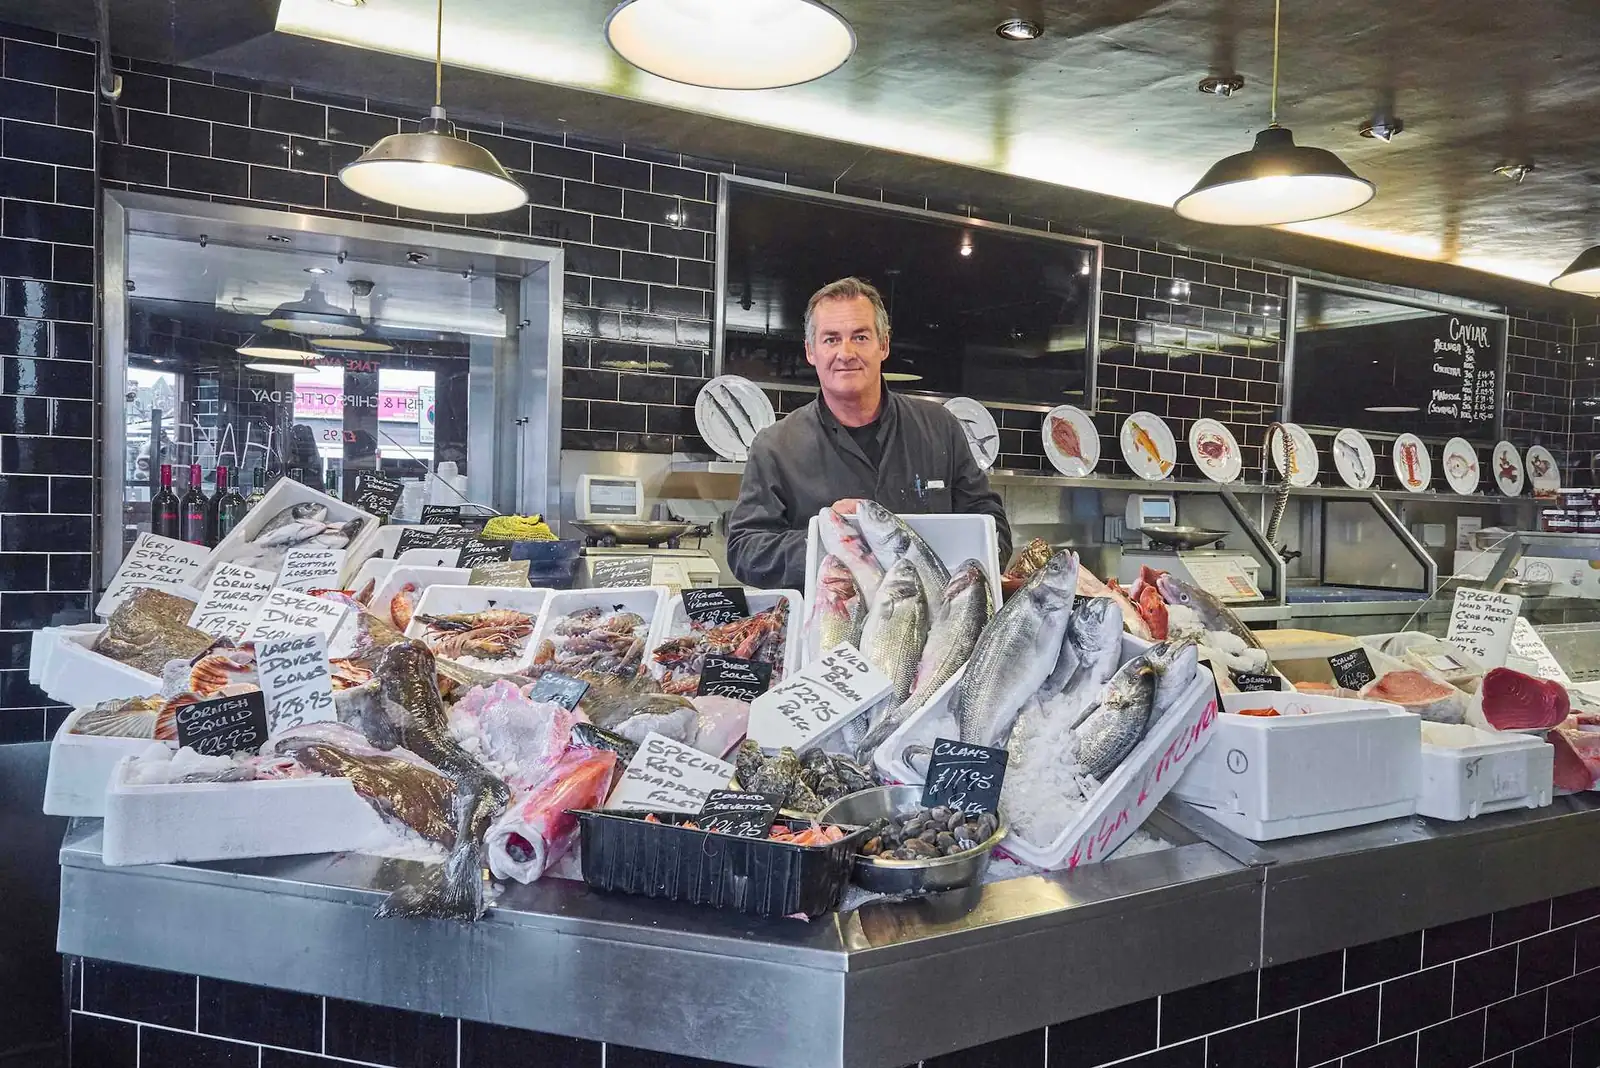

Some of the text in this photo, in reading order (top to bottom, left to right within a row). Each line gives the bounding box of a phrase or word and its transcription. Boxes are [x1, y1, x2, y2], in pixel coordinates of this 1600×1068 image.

[1449, 317, 1490, 348] CAVIAR
[1433, 338, 1462, 355] BELUGA
[142, 534, 175, 553] VERY
[136, 549, 199, 567] SPECIAL
[288, 551, 334, 559] COOKED
[128, 560, 183, 574] SKREI
[216, 565, 256, 579] WILD
[285, 569, 338, 577] LOBSTERS
[287, 561, 336, 569] SCOTTISH
[121, 570, 147, 578] COD
[213, 576, 271, 592] CORNISH
[213, 590, 264, 602] TURBOT
[686, 590, 725, 600] TIGER
[1457, 590, 1514, 605] SPECIAL
[204, 600, 248, 611] SMALL
[270, 593, 339, 616] SPECIAL
[688, 599, 734, 609] PRAWNS
[1458, 602, 1514, 615] HAND PICKED
[262, 608, 318, 628] DIVER
[1455, 610, 1508, 624] CRAB MEAT
[260, 636, 316, 657] LARGE
[260, 651, 322, 675] DOVER
[706, 658, 751, 671] DOVER
[821, 657, 853, 680] SEA
[834, 648, 869, 673] WILD
[273, 665, 327, 689] SOLES
[719, 670, 759, 680] SOLES
[821, 671, 863, 702] BREAM
[177, 699, 249, 724] CORNISH
[186, 711, 252, 736] SQUID
[934, 742, 990, 759] CLAMS
[645, 756, 683, 778] RED
[647, 739, 731, 779] SPECIAL
[647, 790, 699, 809] FILLET
[710, 792, 765, 801] COOKED
[703, 801, 774, 812] CREVETTES
